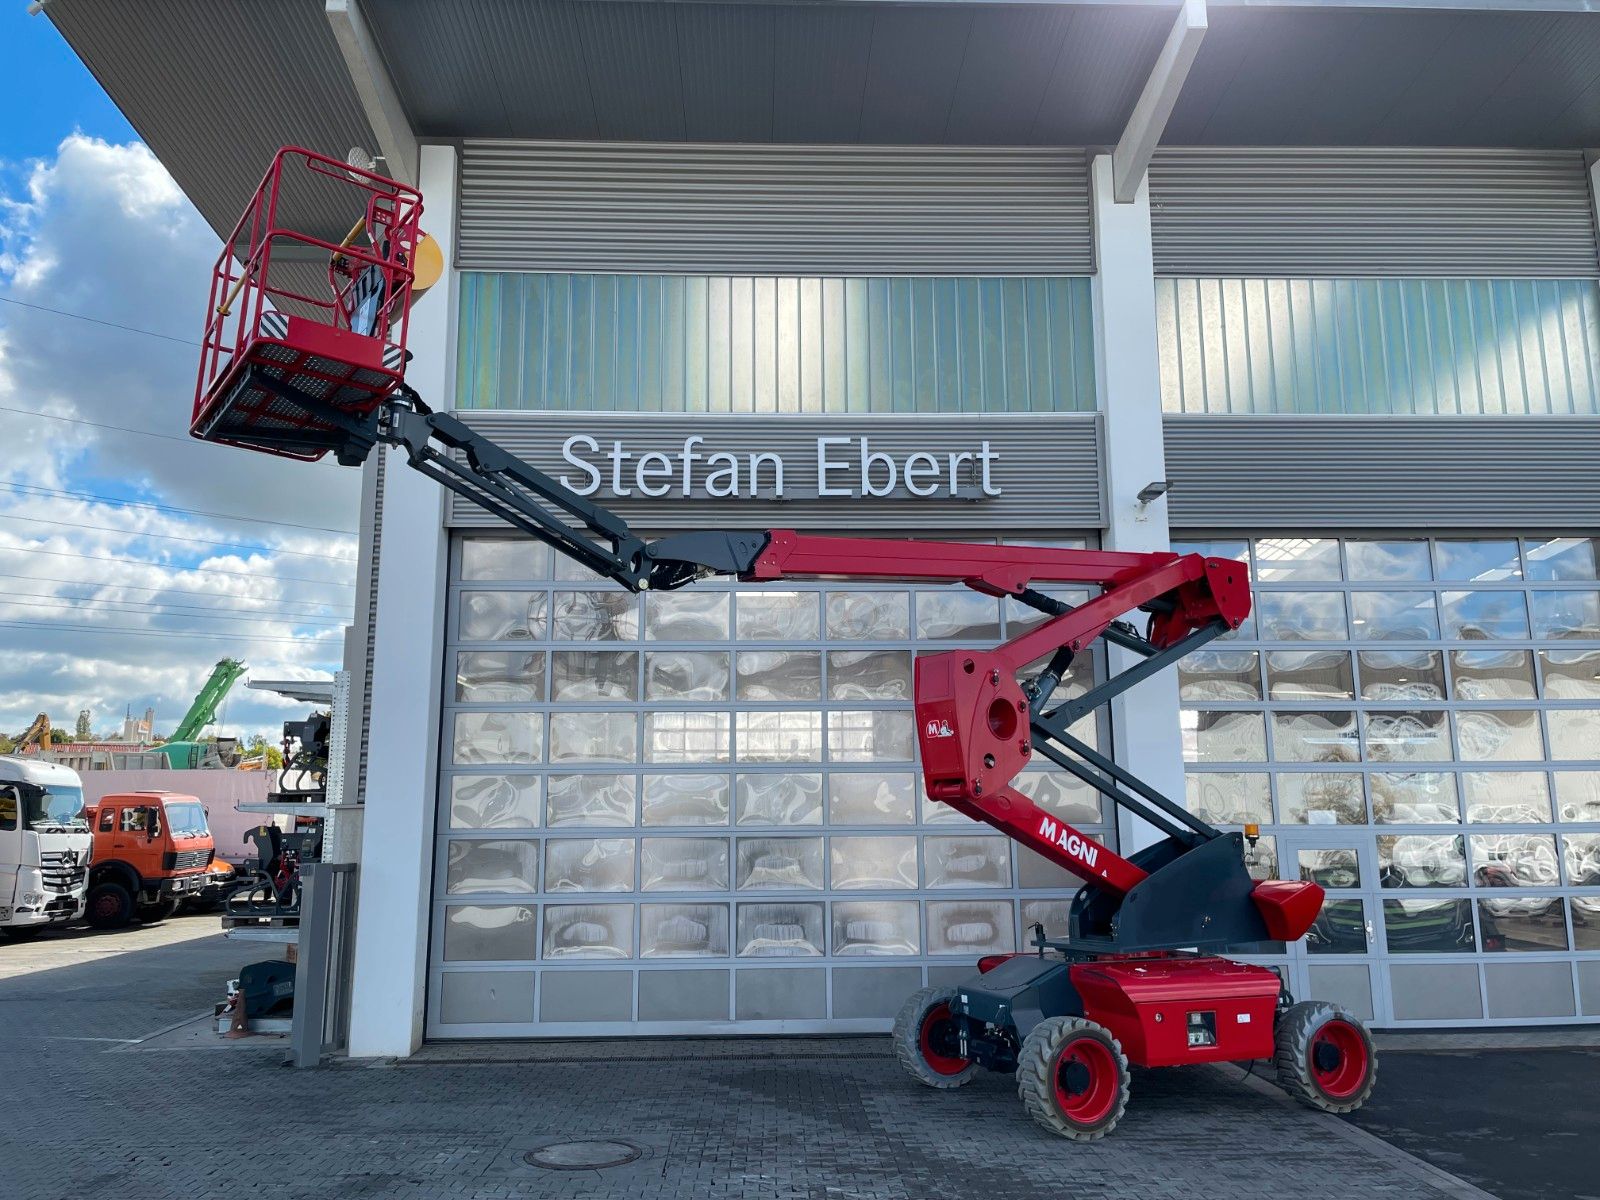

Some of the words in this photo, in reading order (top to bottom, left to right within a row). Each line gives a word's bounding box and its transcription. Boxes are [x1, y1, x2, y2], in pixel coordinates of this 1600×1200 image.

[559, 434, 785, 497] Stefan
[817, 436, 1002, 497] Ebert
[1039, 816, 1098, 868] MAGNI
